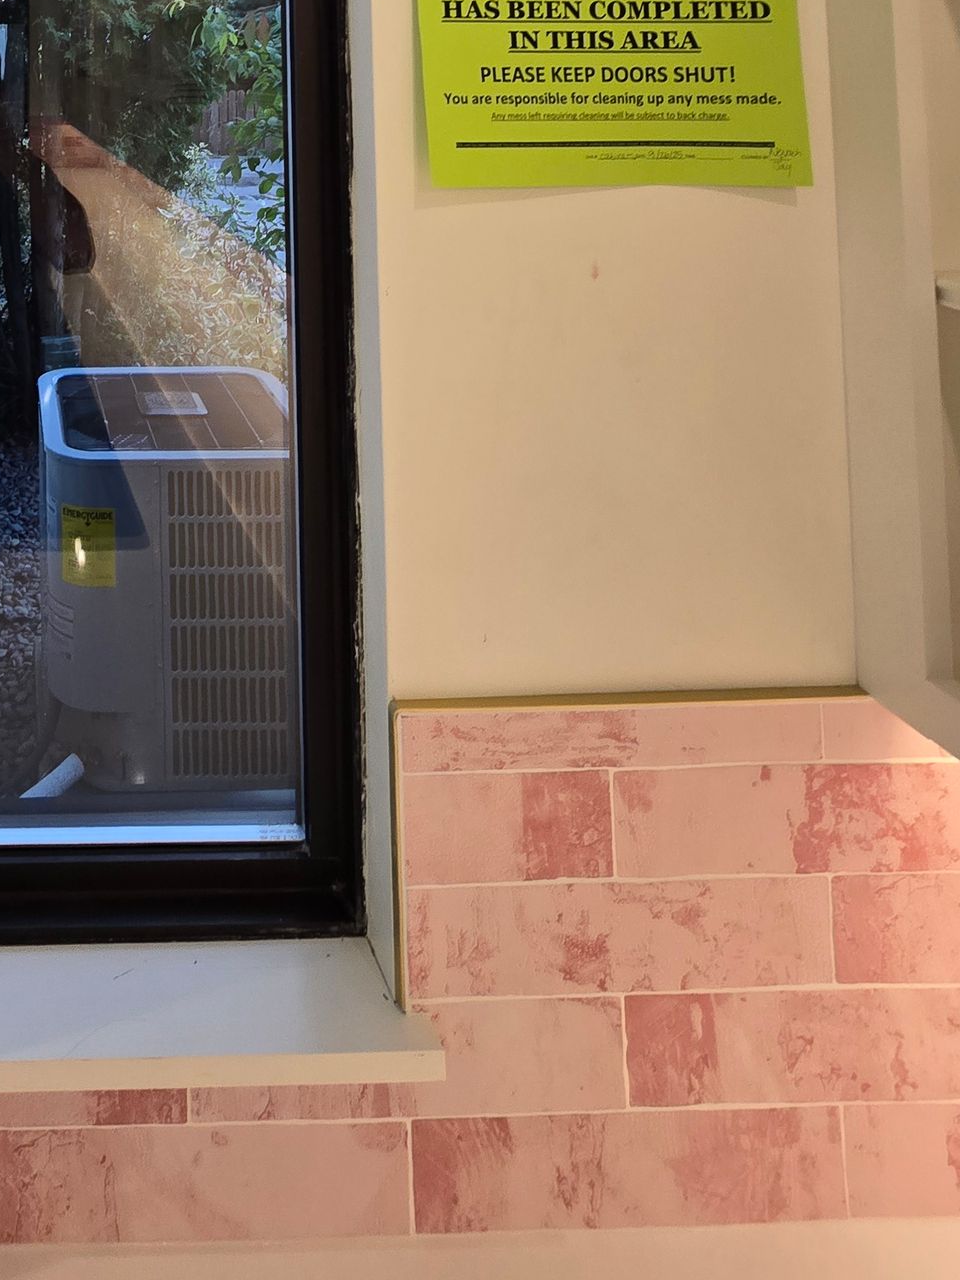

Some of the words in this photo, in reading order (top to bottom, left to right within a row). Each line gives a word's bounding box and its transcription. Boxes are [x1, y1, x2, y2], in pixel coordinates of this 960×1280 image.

[442, 0, 500, 19] HAS
[507, 0, 583, 19] BEEN
[589, 0, 772, 20] COMPLETED
[508, 30, 540, 50] IN
[546, 30, 615, 50] THIS
[620, 30, 702, 50] AREA
[480, 66, 546, 83] PLEASE
[551, 66, 596, 83] KEEP
[601, 66, 668, 83] DOORS
[673, 66, 736, 83] SHUT!
[444, 93, 468, 105] You
[472, 95, 492, 105] are
[496, 92, 568, 107] responsible
[571, 92, 589, 105] for
[592, 92, 644, 107] cleaning
[647, 95, 664, 107] up
[668, 94, 693, 107] any
[696, 94, 732, 105] mess
[736, 92, 782, 105] made.
[491, 112, 506, 121] Any
[610, 112, 624, 121] will
[625, 112, 635, 121] be
[636, 112, 664, 121] subject
[666, 112, 675, 121] to
[677, 112, 696, 121] back
